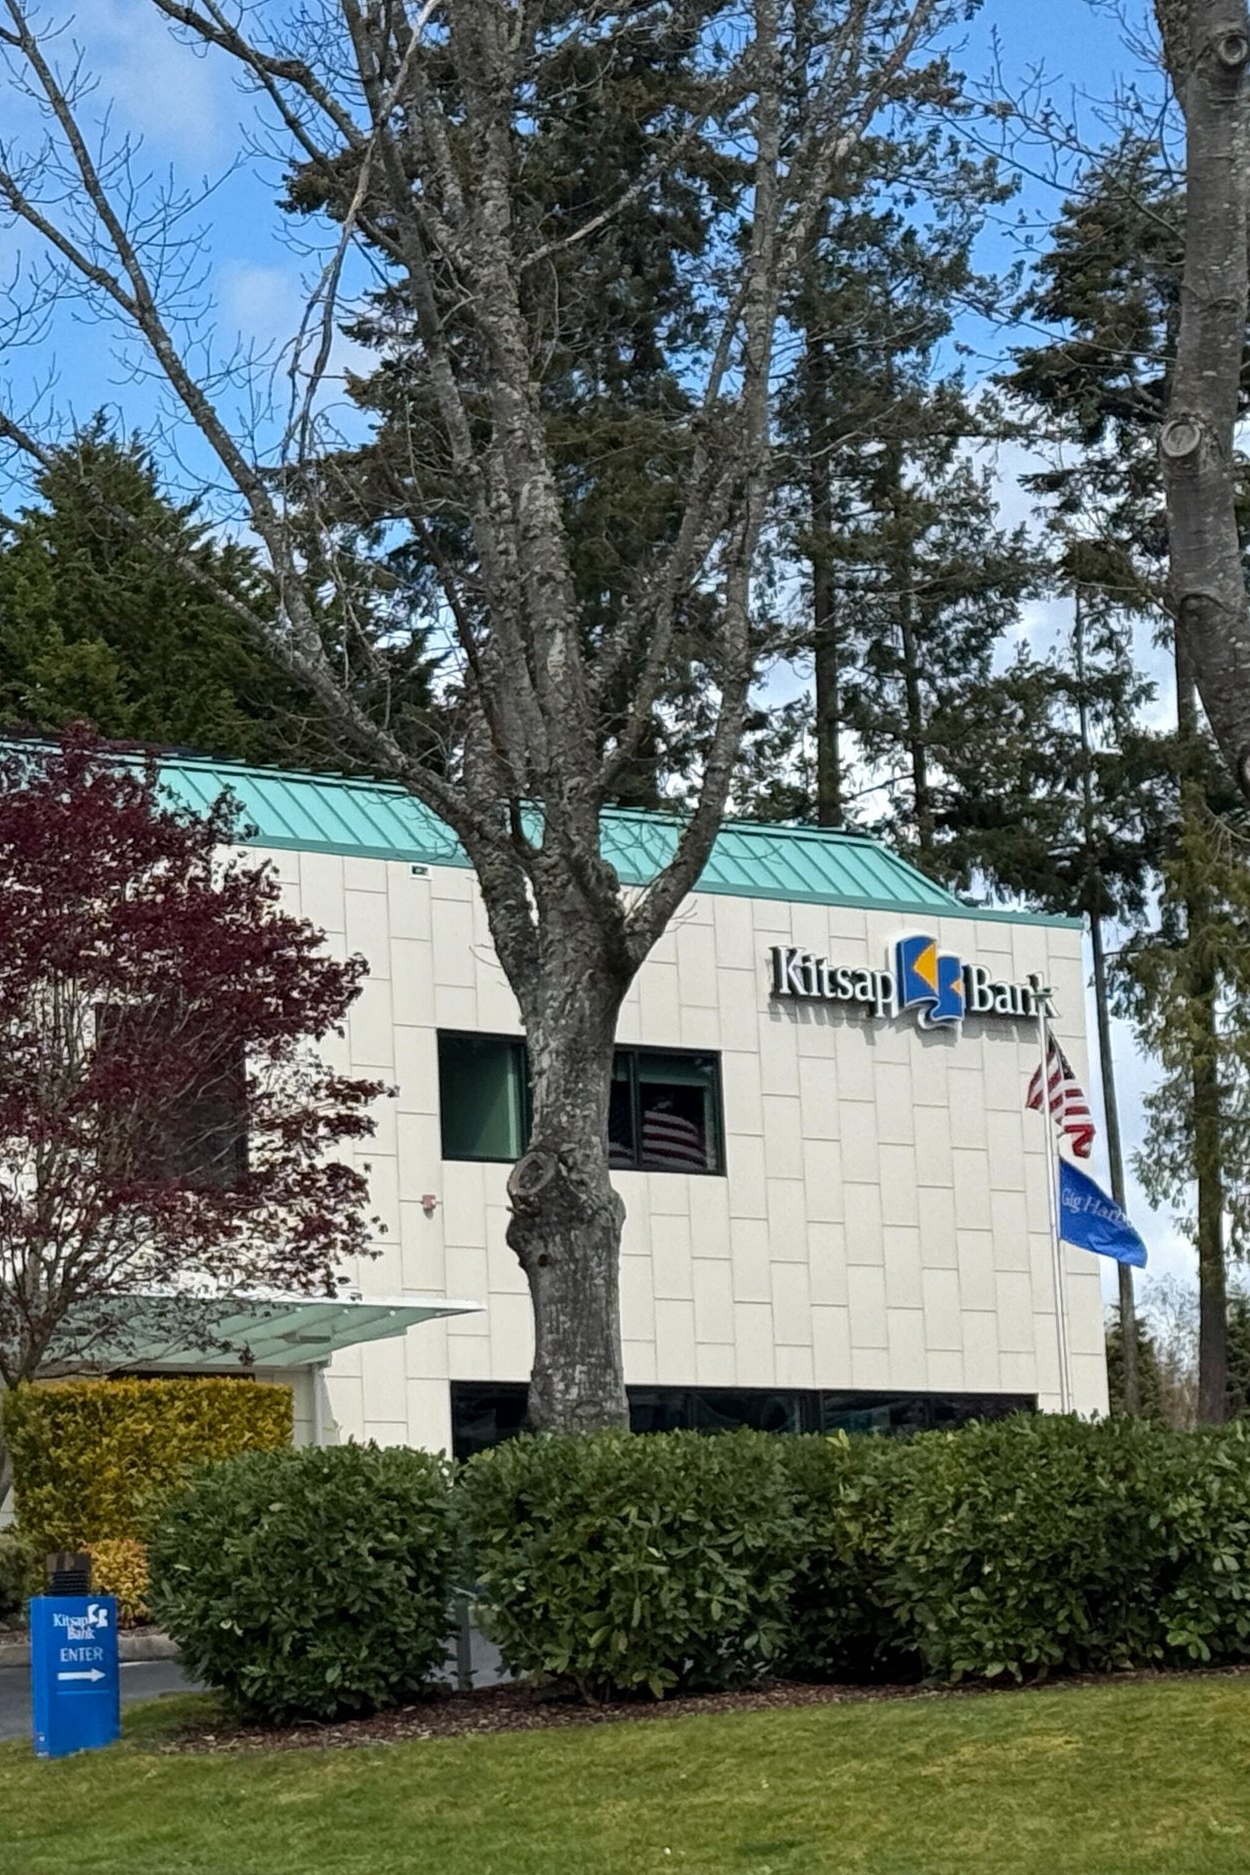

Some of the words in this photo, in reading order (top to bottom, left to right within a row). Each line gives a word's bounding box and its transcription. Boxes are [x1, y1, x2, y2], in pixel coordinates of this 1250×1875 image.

[772, 945, 898, 1018] Kitsap
[969, 964, 1061, 1018] Bank
[1061, 1187, 1082, 1214] Gig
[1083, 1194, 1134, 1228] Harbo
[52, 1612, 88, 1628] Kitsap
[67, 1624, 96, 1640] Bank
[60, 1646, 104, 1662] ENTER
